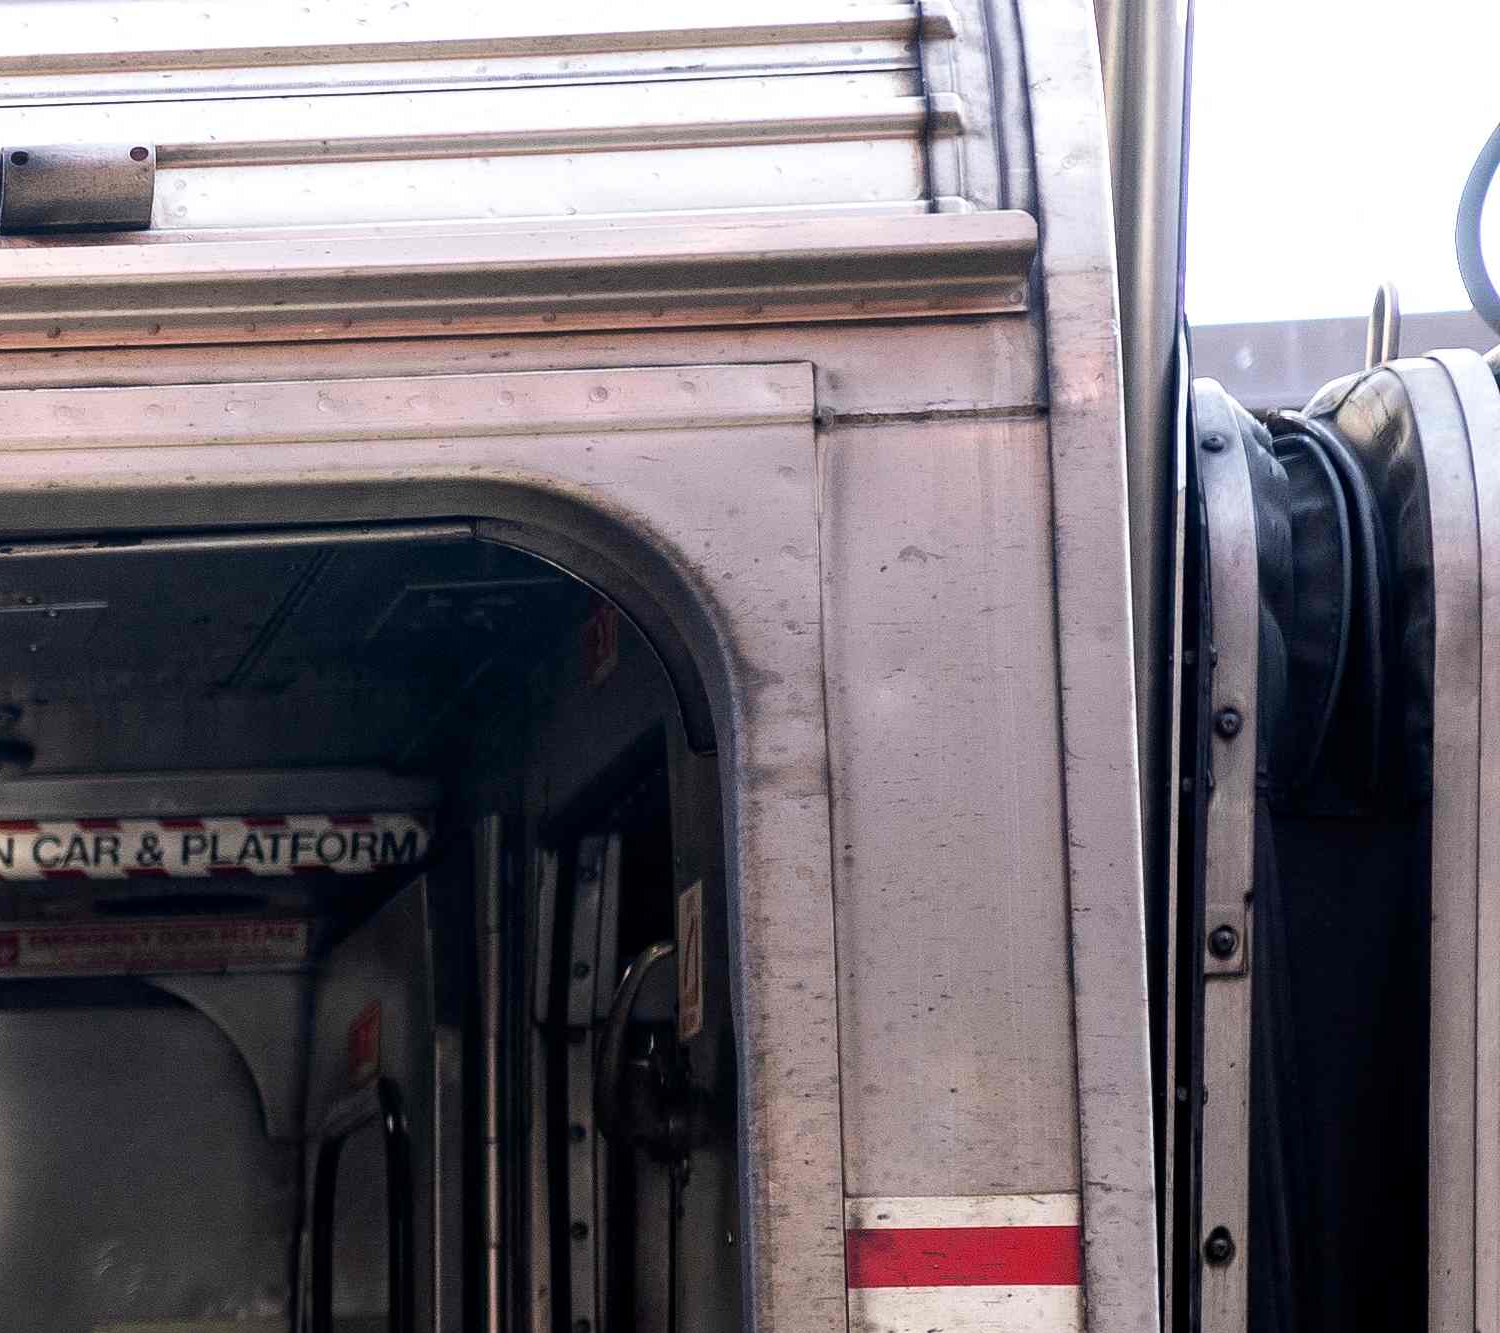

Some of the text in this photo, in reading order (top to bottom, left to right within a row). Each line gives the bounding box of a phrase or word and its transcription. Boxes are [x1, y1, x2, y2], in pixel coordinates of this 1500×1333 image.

[32, 834, 121, 868] CAR
[135, 832, 165, 867] &
[180, 828, 419, 866] PLATFORM
